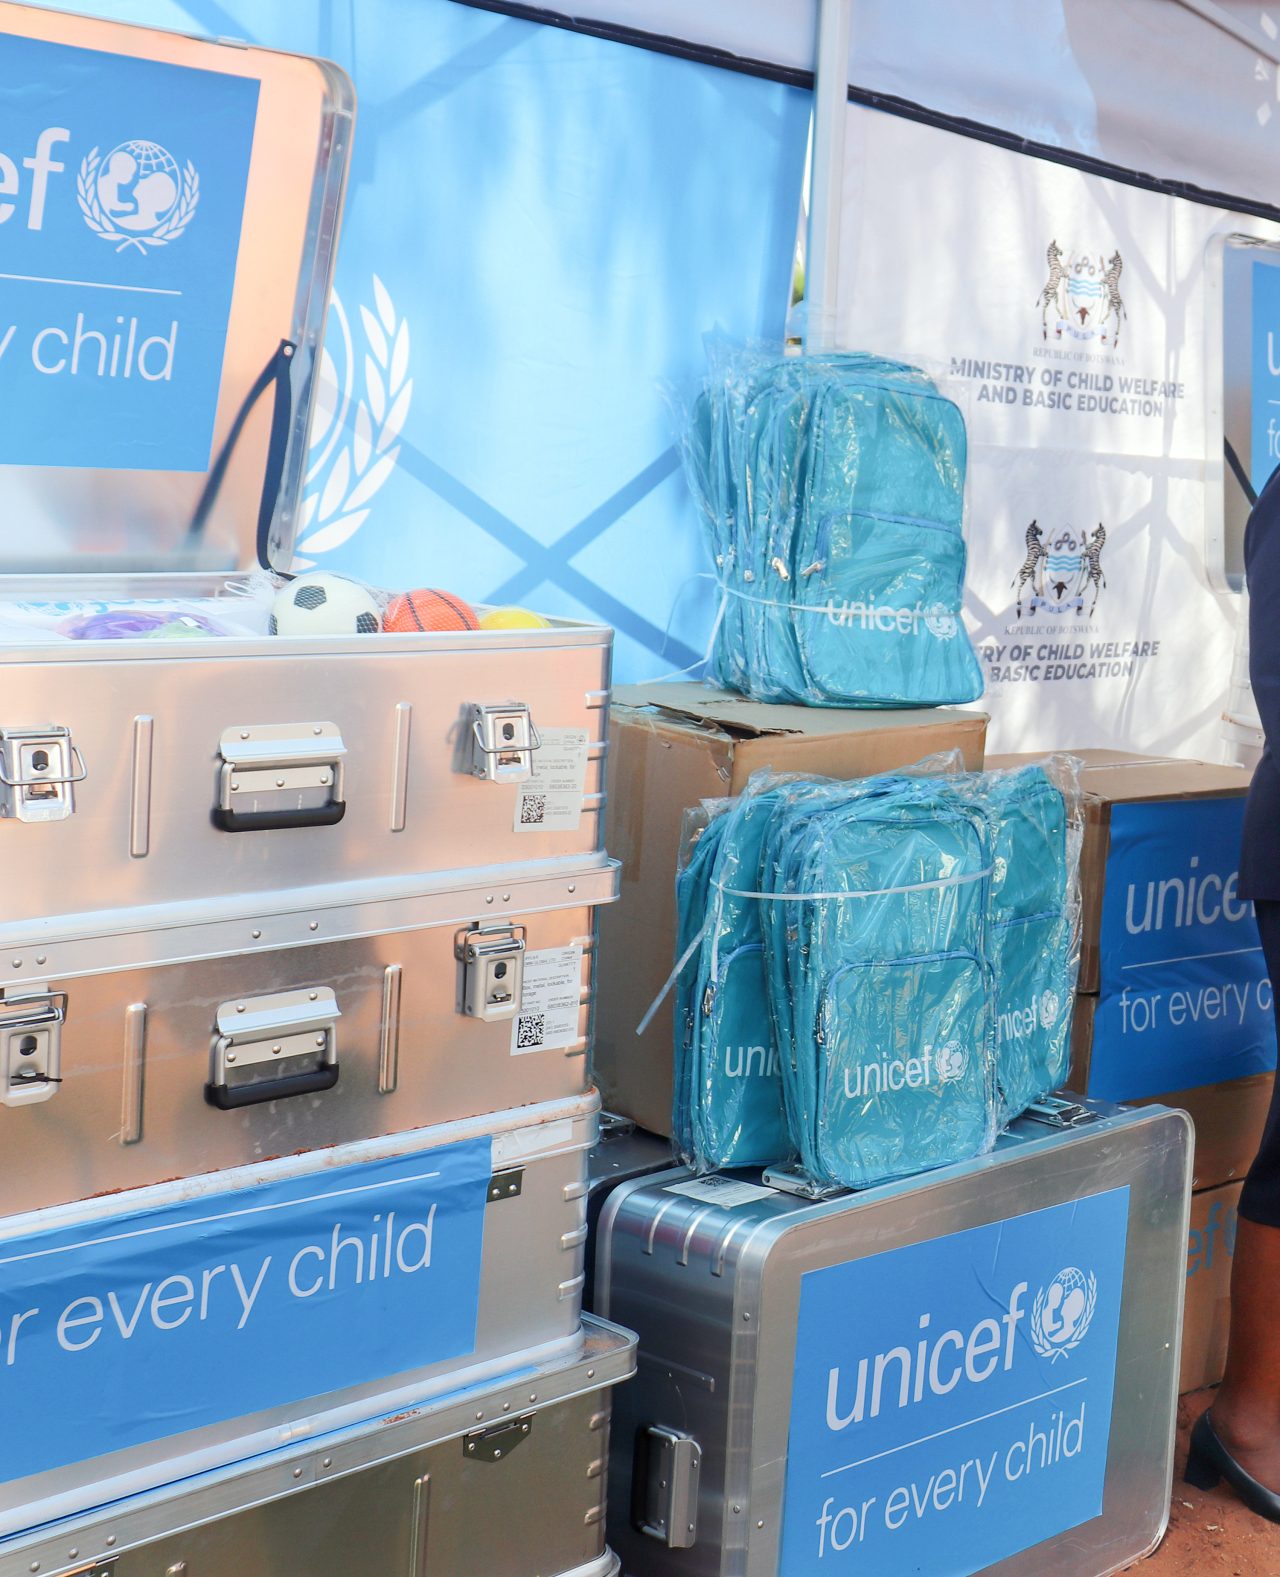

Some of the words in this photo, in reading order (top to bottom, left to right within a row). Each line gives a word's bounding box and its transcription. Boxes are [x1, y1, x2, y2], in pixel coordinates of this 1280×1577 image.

[31, 312, 179, 382] child
[950, 357, 1035, 385] MINISTRY
[1041, 368, 1063, 387] OF
[1067, 371, 1114, 392] CHILD
[1118, 376, 1185, 399] WELFARE
[977, 384, 1017, 404] AND
[1022, 388, 1073, 411] BASIC
[1077, 394, 1164, 418] EDUCATION
[827, 595, 922, 635] unicef
[1005, 625, 1044, 635] REPUBLIC
[1046, 625, 1056, 635] OF
[991, 664, 1041, 682] BASIC
[1044, 660, 1133, 681] EDUCATION
[1010, 645, 1034, 662] OF
[1037, 643, 1084, 661] CHILD
[1090, 641, 1161, 659] WELFARE
[1126, 856, 1256, 935] unice
[998, 995, 1037, 1043] nicef
[1119, 986, 1161, 1034] for
[1169, 981, 1250, 1025] every
[725, 1046, 780, 1077] uni
[844, 1044, 932, 1098] unicef
[56, 1255, 273, 1352] every
[288, 1203, 438, 1298] child
[826, 1281, 1028, 1431] unicef
[816, 1497, 876, 1558] for
[884, 1451, 998, 1530] every
[1005, 1401, 1086, 1482] child
